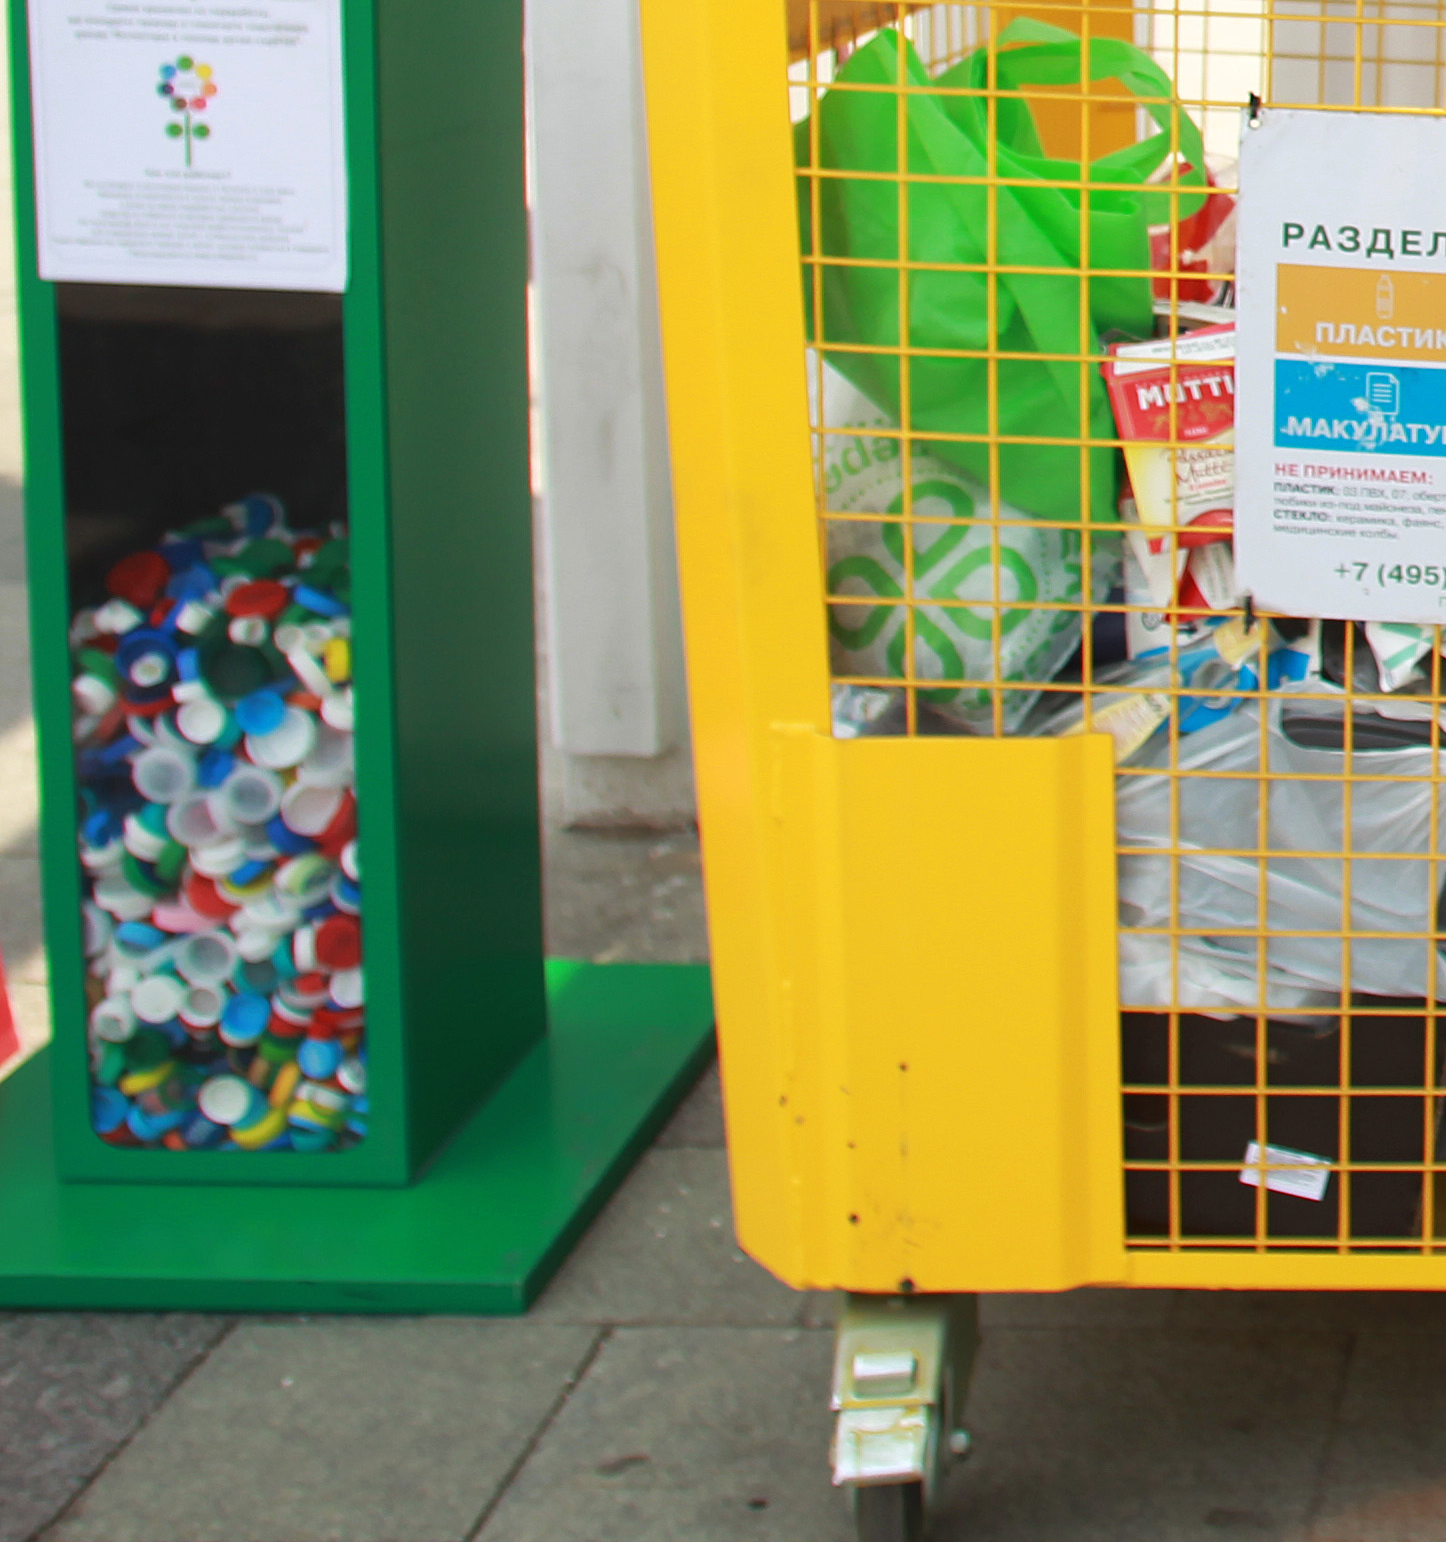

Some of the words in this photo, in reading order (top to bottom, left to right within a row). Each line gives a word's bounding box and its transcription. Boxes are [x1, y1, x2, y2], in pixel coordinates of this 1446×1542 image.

[1136, 374, 1235, 411] MUTTI
[1274, 463, 1299, 477] НЕ
[1304, 465, 1433, 485] ПРИНИМАЕМ:
[1334, 562, 1369, 582] +7
